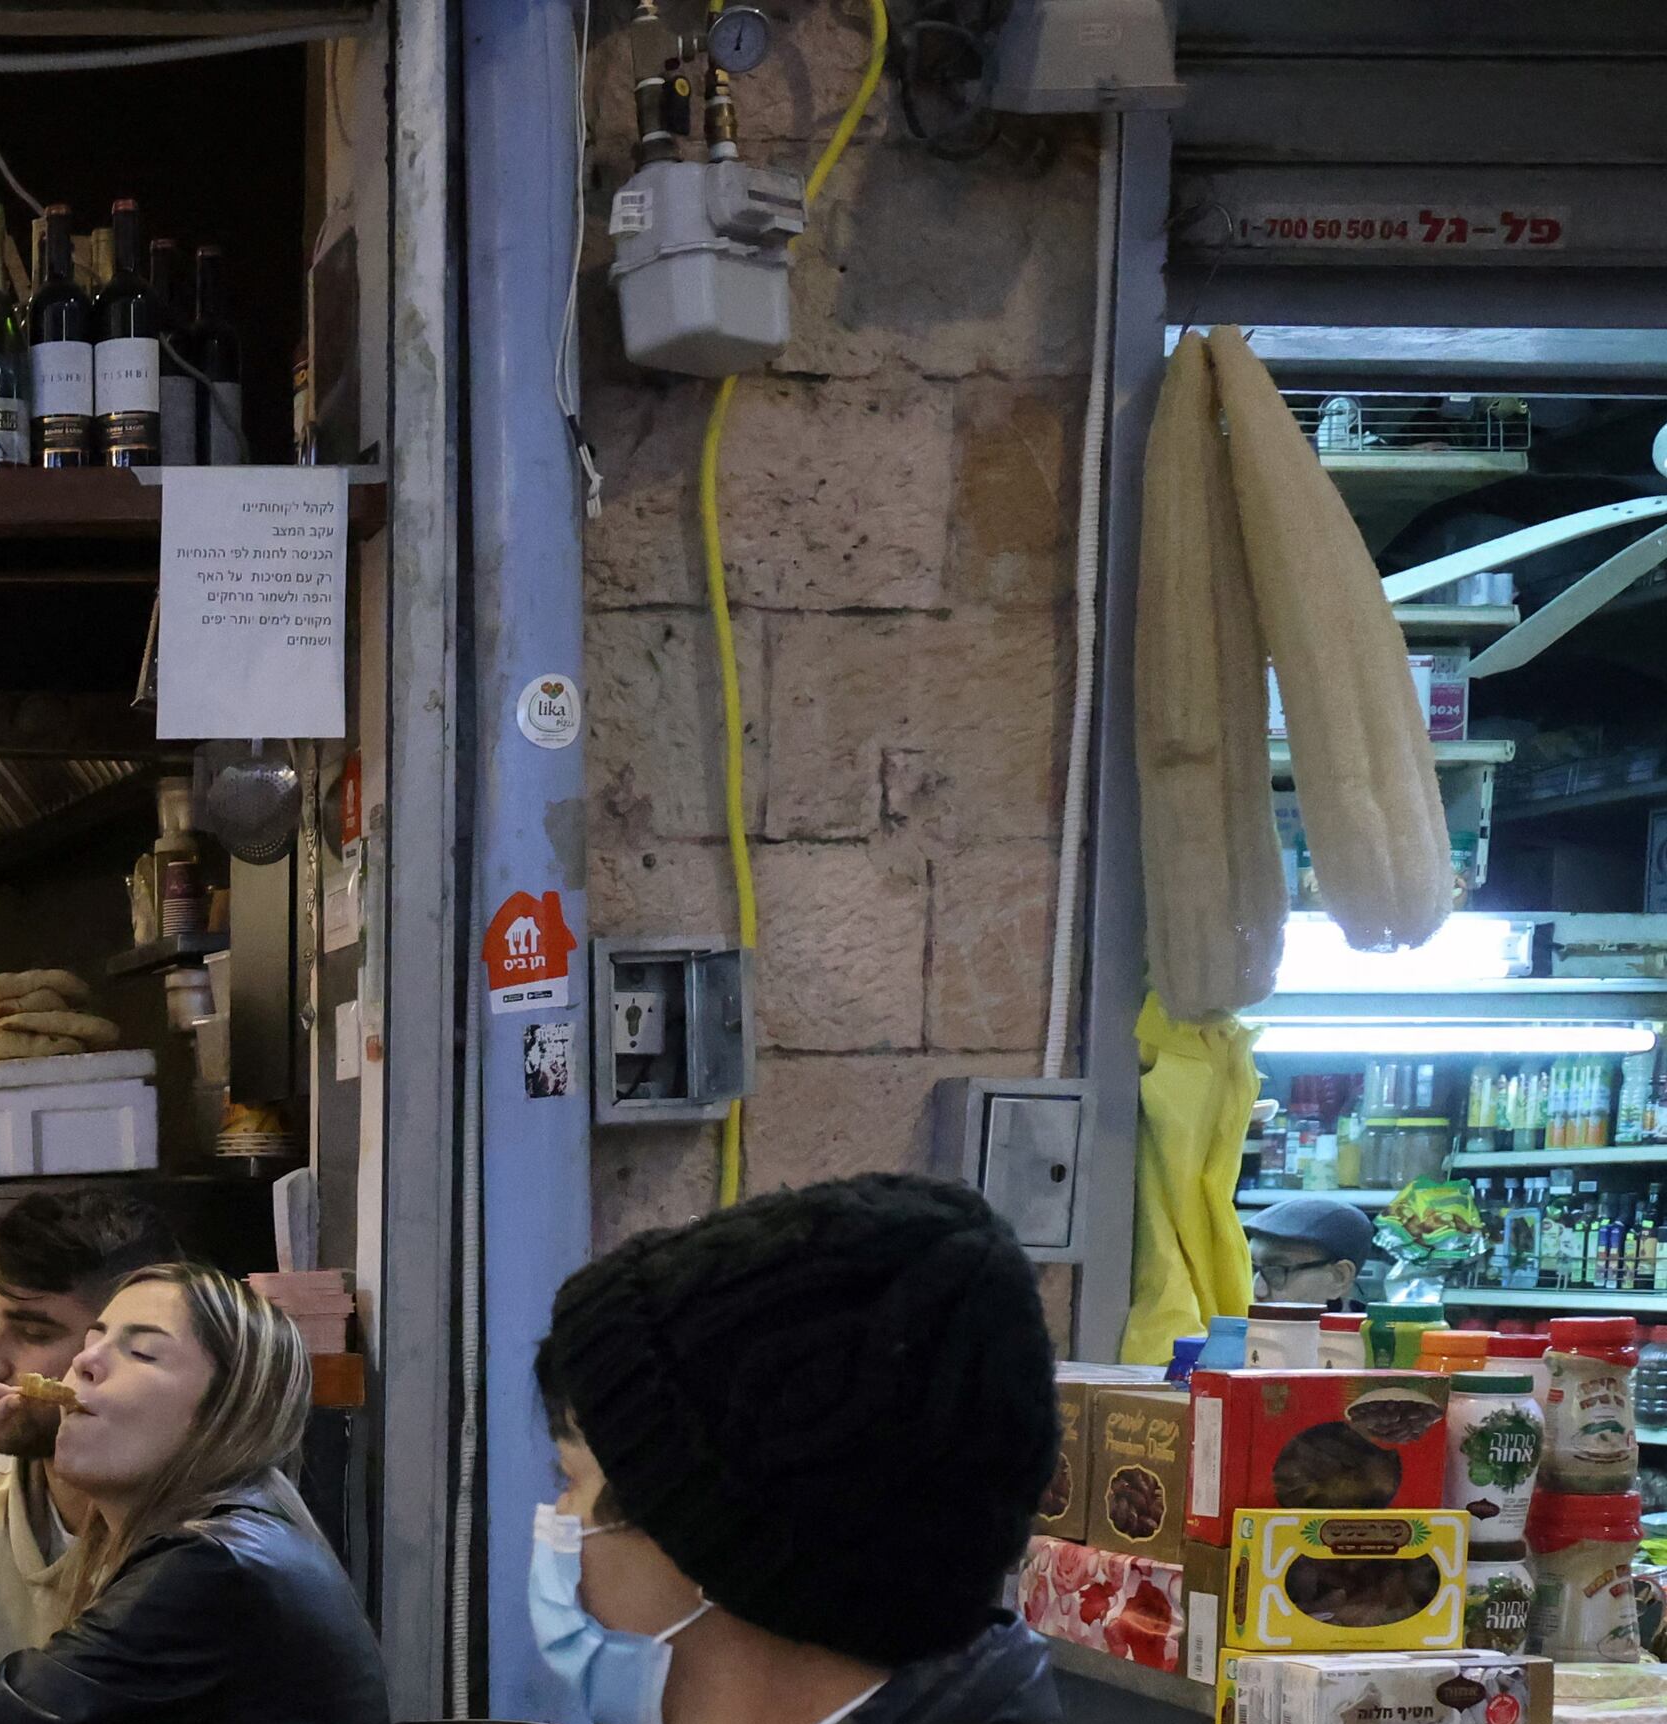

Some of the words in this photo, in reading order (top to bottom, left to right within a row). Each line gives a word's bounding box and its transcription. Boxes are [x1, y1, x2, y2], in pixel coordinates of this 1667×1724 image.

[303, 501, 334, 515] לקהל
[272, 526, 305, 537] המצב
[309, 526, 334, 539] עקב
[177, 548, 225, 559] ההנחיות
[230, 547, 249, 560] לפי
[252, 548, 287, 559] לחנות
[292, 549, 333, 560] הכניסה
[197, 571, 224, 584] האף
[228, 570, 242, 581] על
[251, 572, 292, 583] מסיכות
[296, 573, 312, 583] עם
[316, 573, 332, 585] רק
[207, 591, 253, 604] מרחקים
[258, 591, 299, 602] ולשמור
[302, 593, 332, 603] והפה
[202, 615, 226, 625] יפים
[259, 614, 291, 626] לימים
[295, 615, 332, 628] מקווים
[287, 635, 331, 646] ושמחים
[539, 700, 566, 716] lika
[504, 957, 527, 971] ביס
[529, 954, 546, 970] תן
[1490, 1431, 1537, 1449] טחינה
[1397, 1705, 1434, 1720] חטיף
